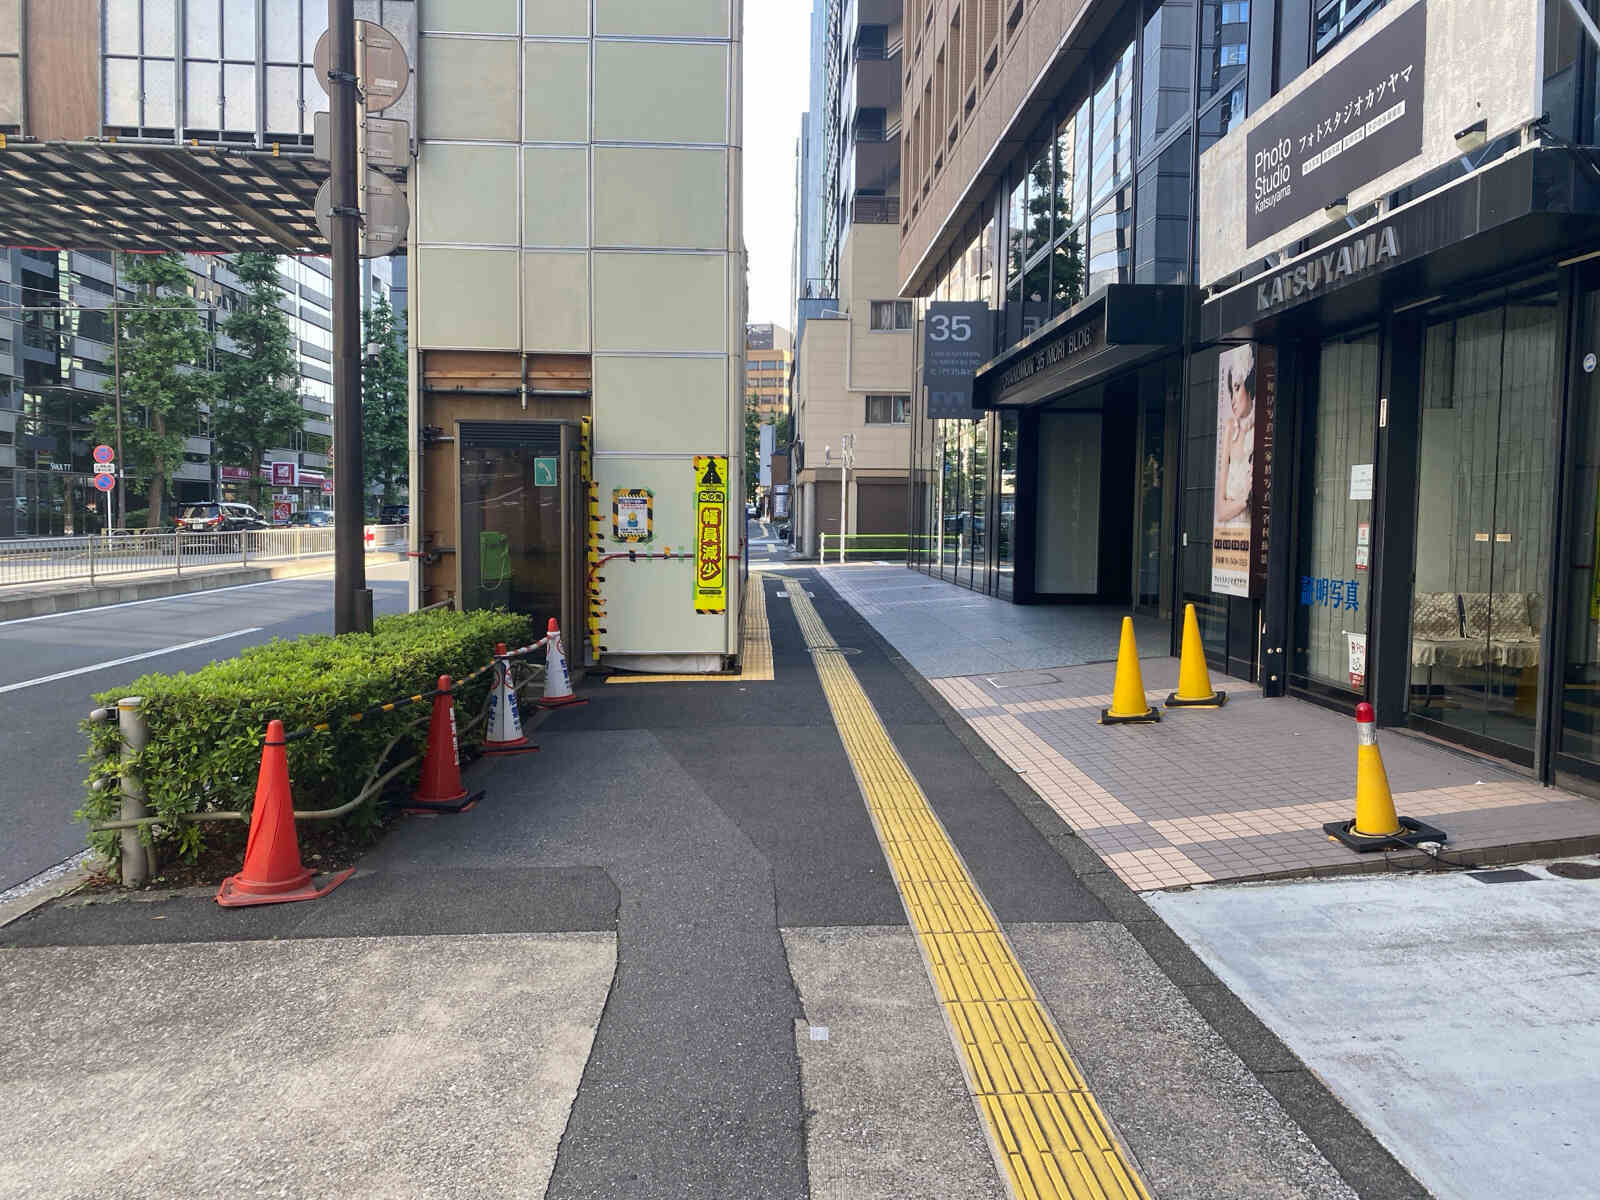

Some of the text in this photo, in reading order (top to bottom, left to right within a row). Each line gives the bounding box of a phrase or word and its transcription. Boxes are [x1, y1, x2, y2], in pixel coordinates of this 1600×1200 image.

[1299, 64, 1413, 153] フォトスタジオカツヤマ
[1255, 138, 1291, 177] Photo
[1255, 164, 1291, 200] Studio
[1255, 184, 1291, 216] Katsuyama
[1257, 226, 1398, 311] KATSUYAMA
[929, 315, 972, 341] 35
